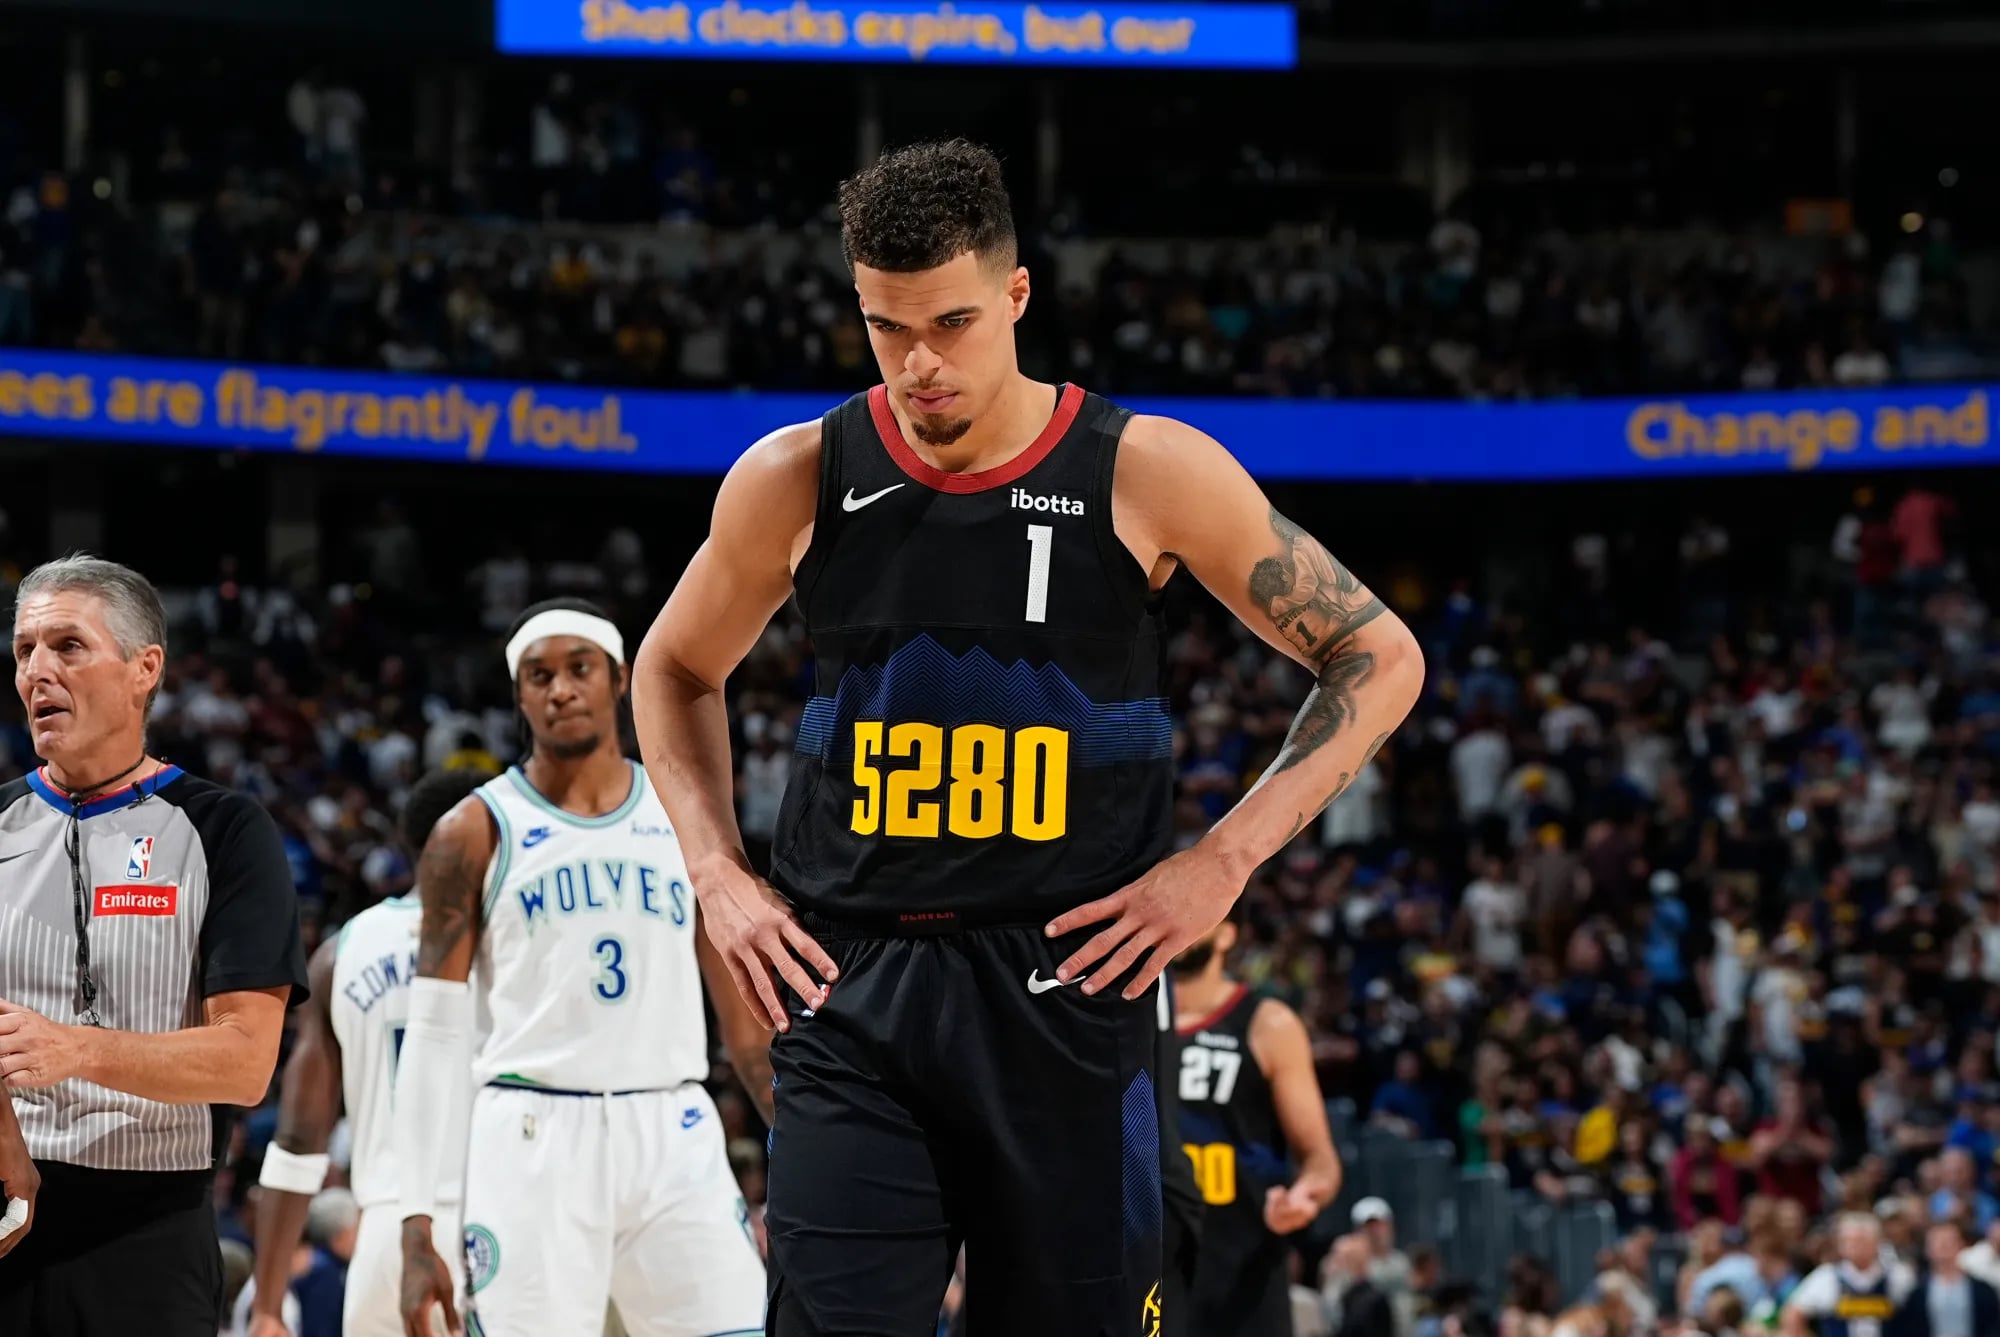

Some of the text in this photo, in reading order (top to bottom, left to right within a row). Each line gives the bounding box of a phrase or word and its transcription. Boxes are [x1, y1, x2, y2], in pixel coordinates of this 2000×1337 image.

[580, 0, 1195, 62] Shot clocks expire, but our
[106, 376, 202, 427] are
[215, 369, 497, 461] flagrantly
[509, 386, 638, 453] foul.
[1626, 390, 1988, 470] Change and
[1010, 487, 1085, 516] ibotta
[1025, 523, 1053, 623] 1
[1296, 621, 1318, 647] 1
[850, 721, 1069, 841] 5280
[101, 891, 169, 909] Emirates
[517, 861, 688, 936] WOLVES
[592, 934, 629, 1003] 3
[1178, 1045, 1242, 1105] 27
